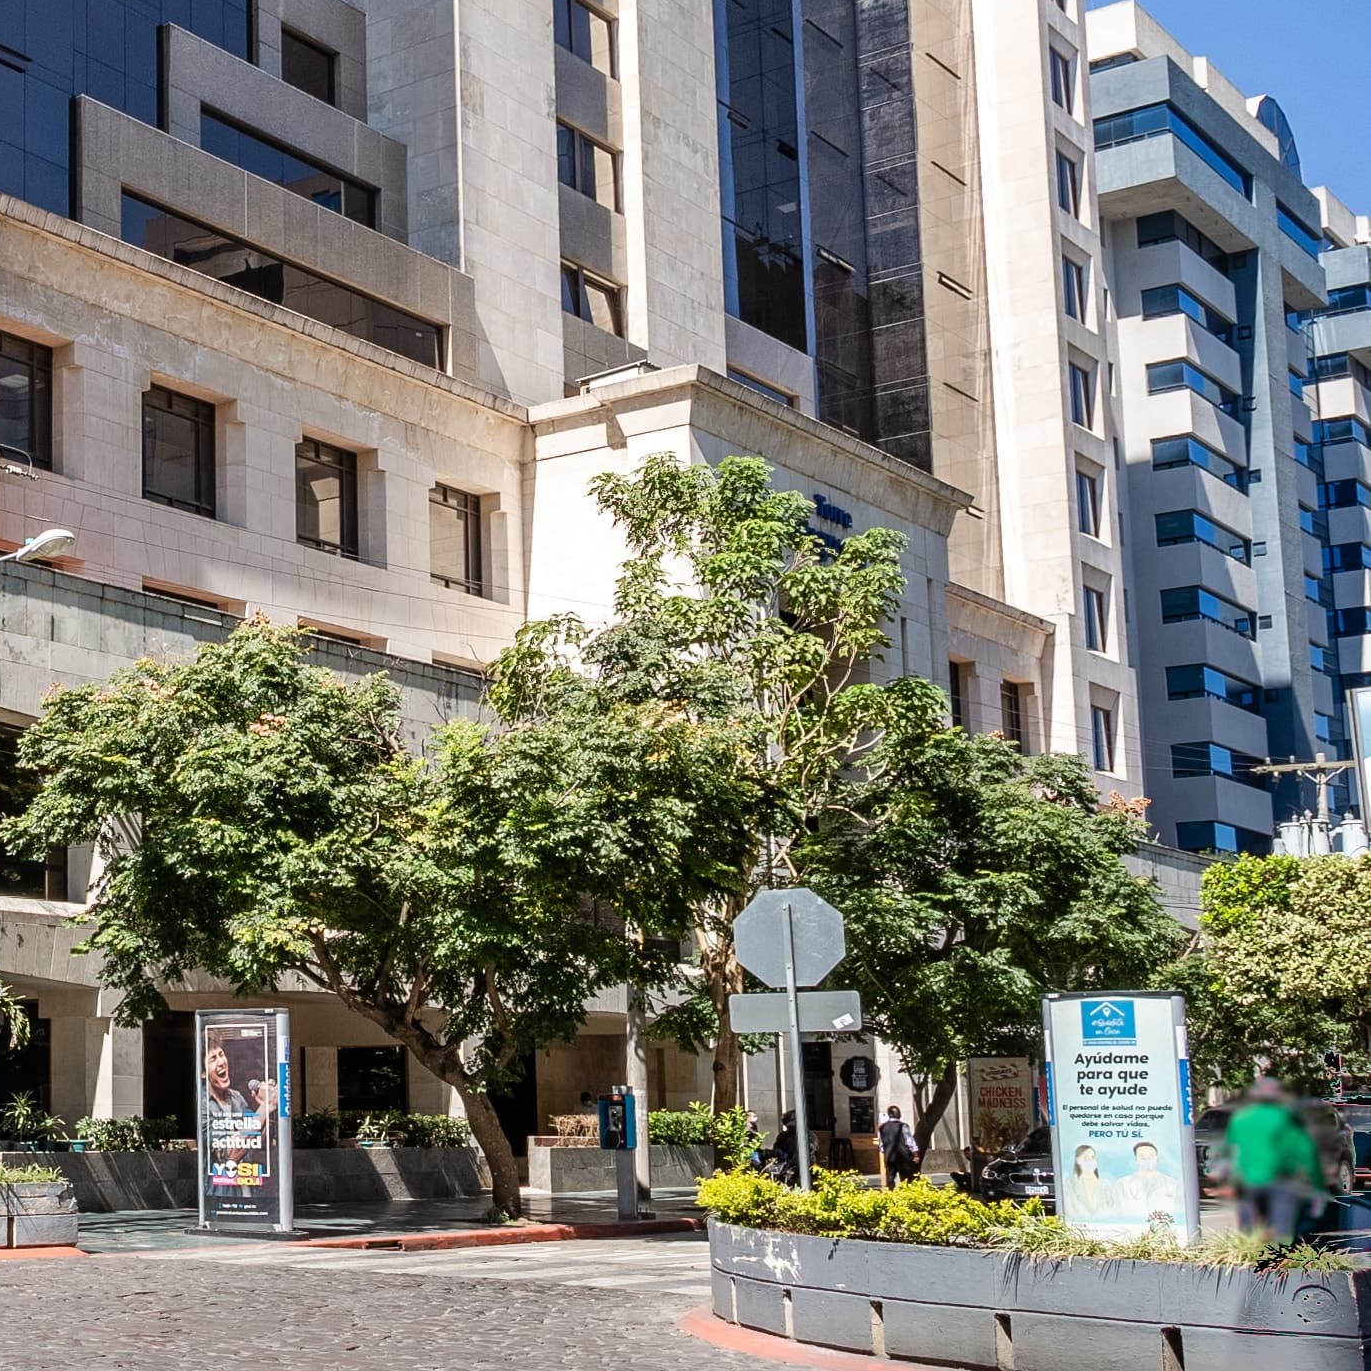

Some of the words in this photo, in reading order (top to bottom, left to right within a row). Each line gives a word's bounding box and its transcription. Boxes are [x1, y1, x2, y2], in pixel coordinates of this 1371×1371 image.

[1074, 1052, 1150, 1068] Ayúdame
[1077, 1070, 1113, 1084] para
[1117, 1070, 1149, 1084] que
[979, 1087, 1022, 1098] CHICKEN
[1079, 1083, 1094, 1096] te
[1097, 1083, 1148, 1099] ayude
[1069, 1104, 1099, 1112] personal
[1147, 1104, 1173, 1112] puede
[1069, 1112, 1102, 1120] quedarse
[212, 1117, 262, 1130] estrella
[1088, 1130, 1114, 1138] PERO
[1116, 1128, 1129, 1138] TÚ
[212, 1136, 262, 1149] actitud
